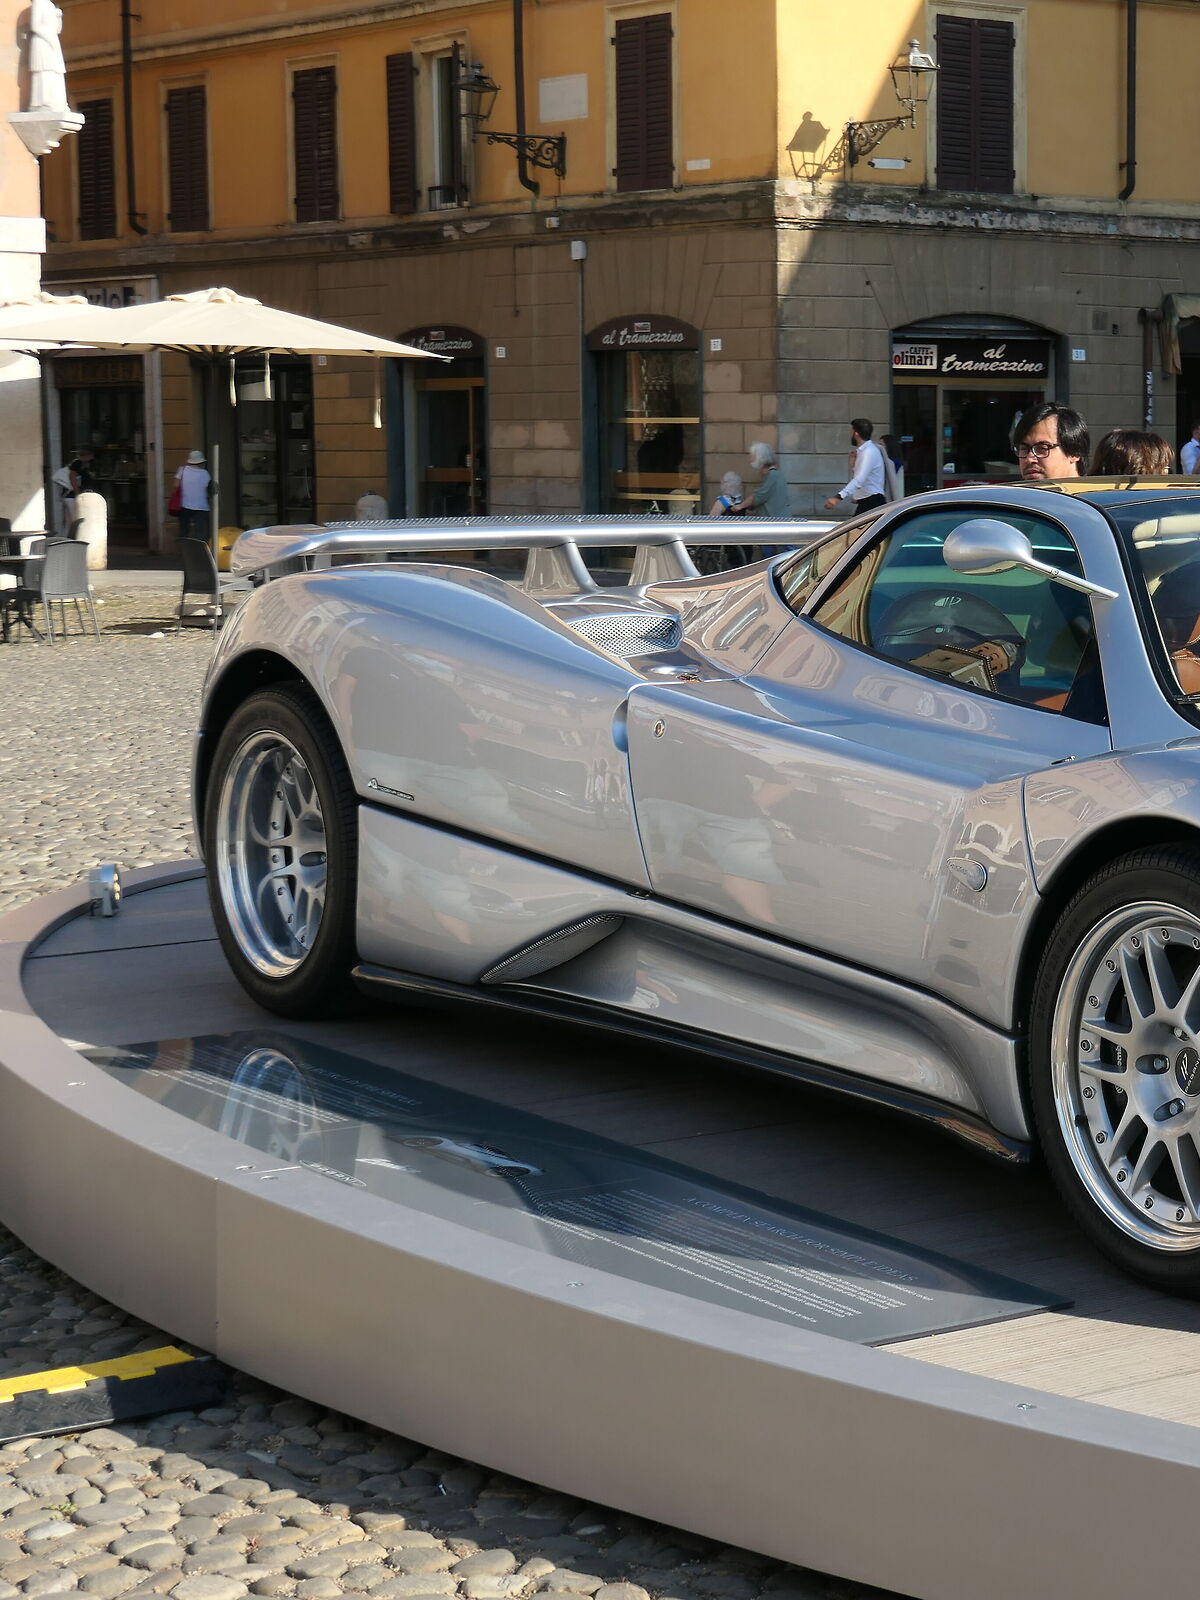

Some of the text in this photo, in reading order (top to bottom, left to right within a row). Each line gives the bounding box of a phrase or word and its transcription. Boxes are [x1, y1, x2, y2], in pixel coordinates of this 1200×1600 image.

[602, 328, 684, 346] al tramezzino
[893, 350, 934, 366] olinari
[984, 344, 1006, 359] al
[941, 353, 1046, 373] tramezzino
